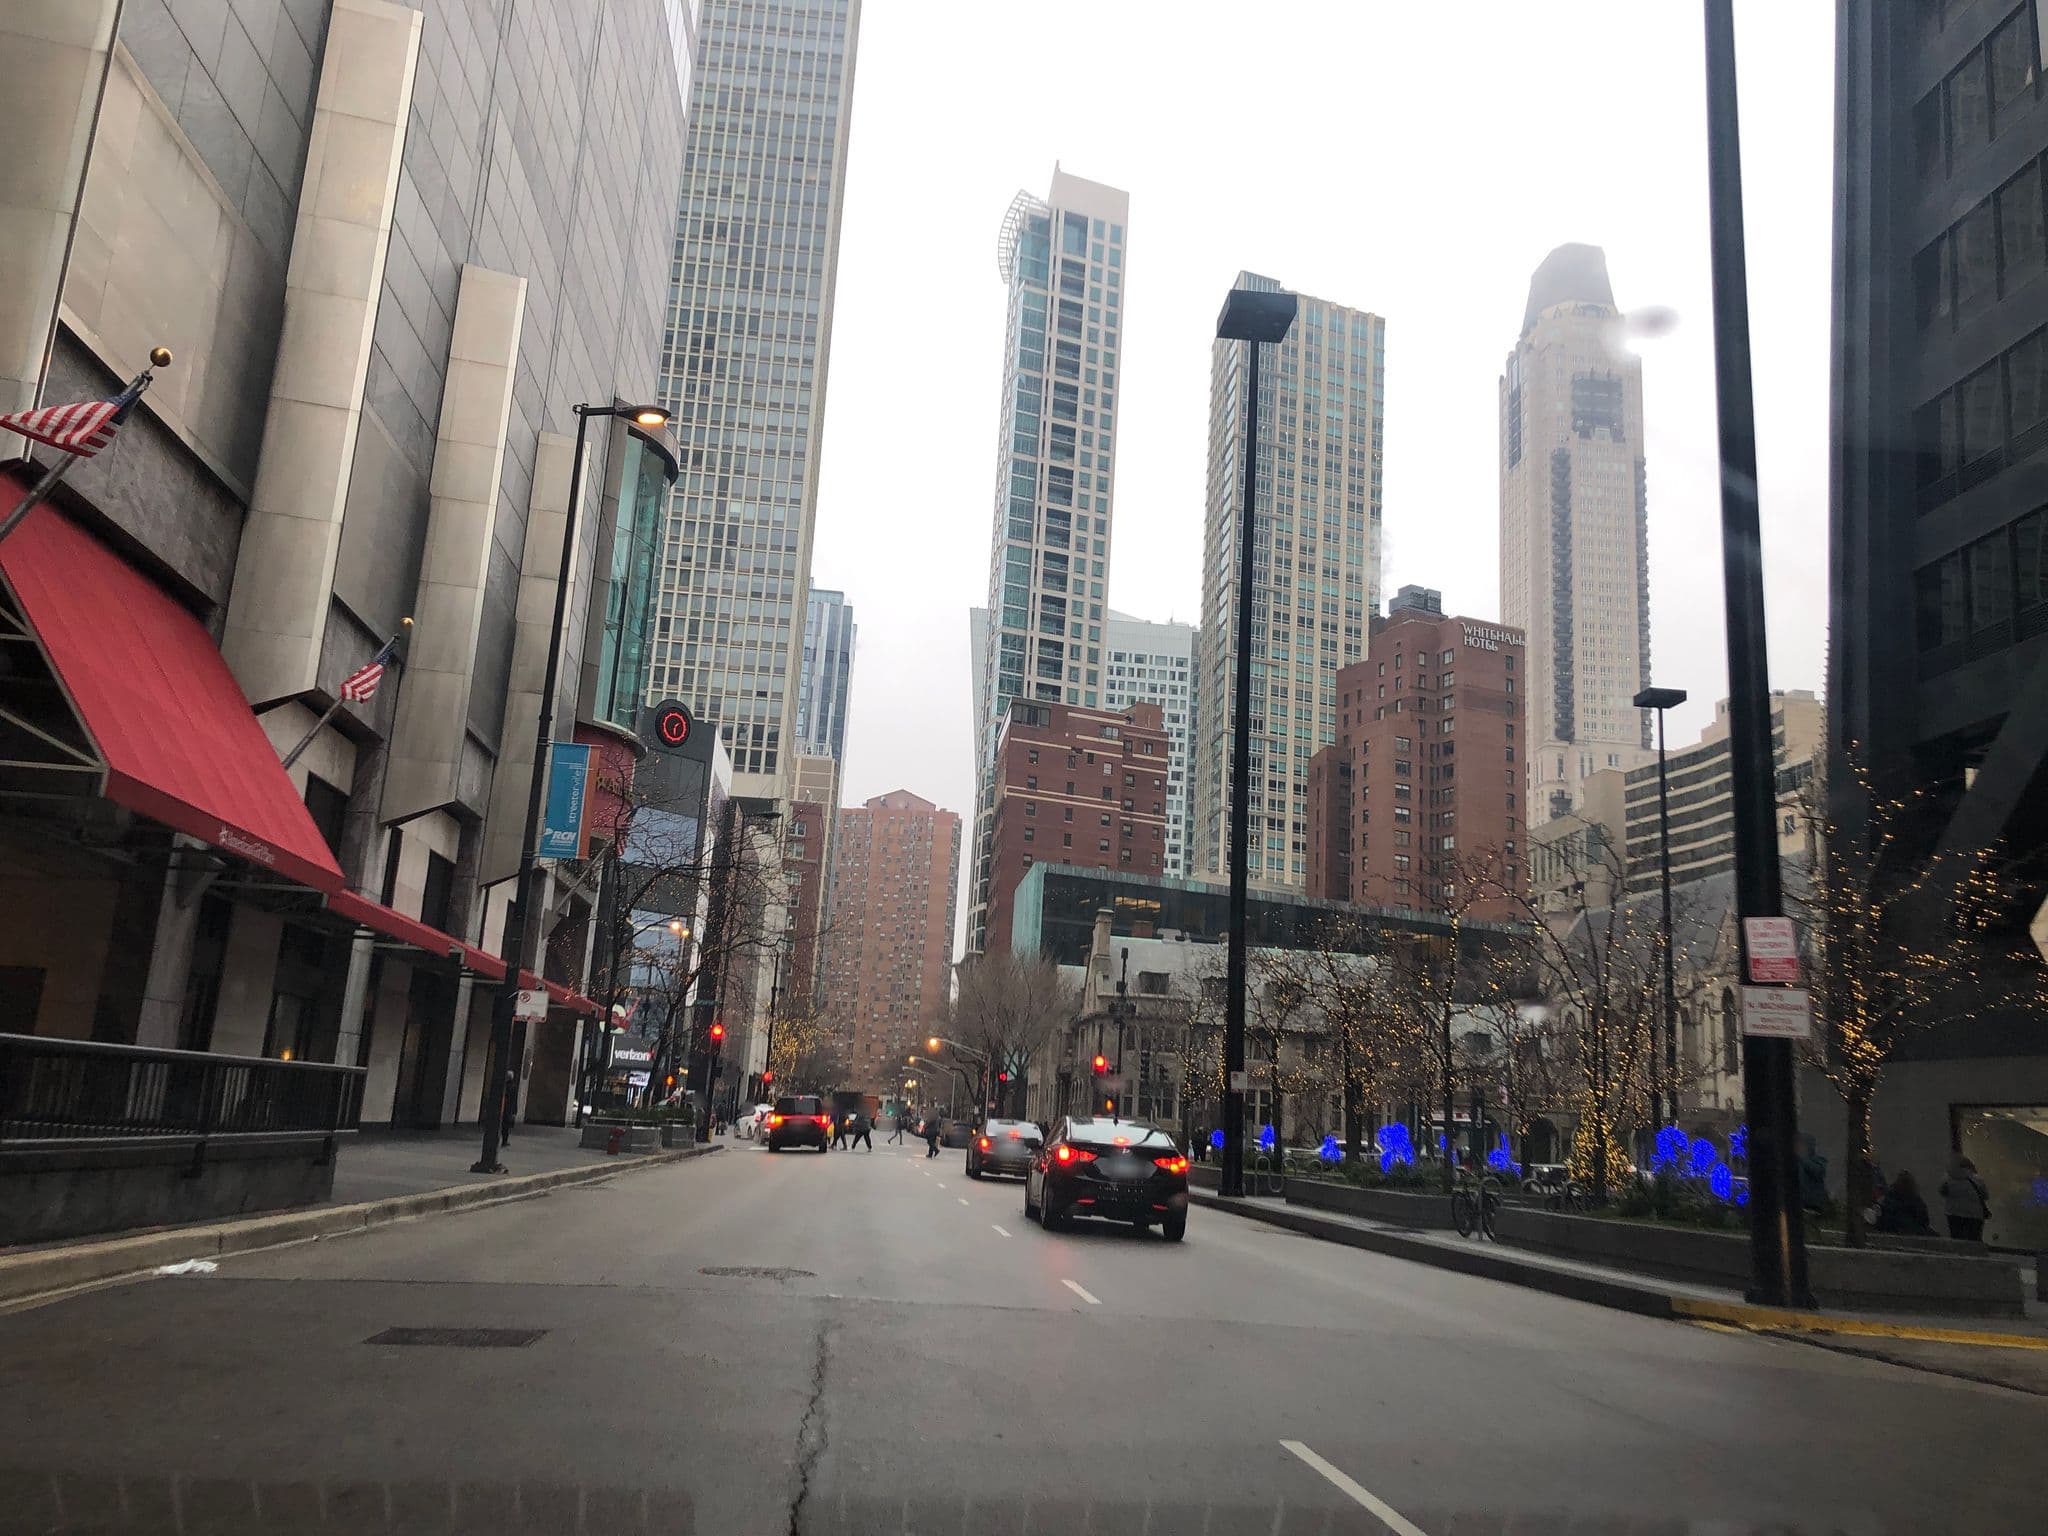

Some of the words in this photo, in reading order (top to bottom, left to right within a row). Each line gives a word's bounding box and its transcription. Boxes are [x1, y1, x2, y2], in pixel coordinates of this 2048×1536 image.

[1460, 622, 1525, 646] WHITEHALL
[1464, 635, 1498, 652] HOTEL
[614, 1047, 649, 1060] verizon
